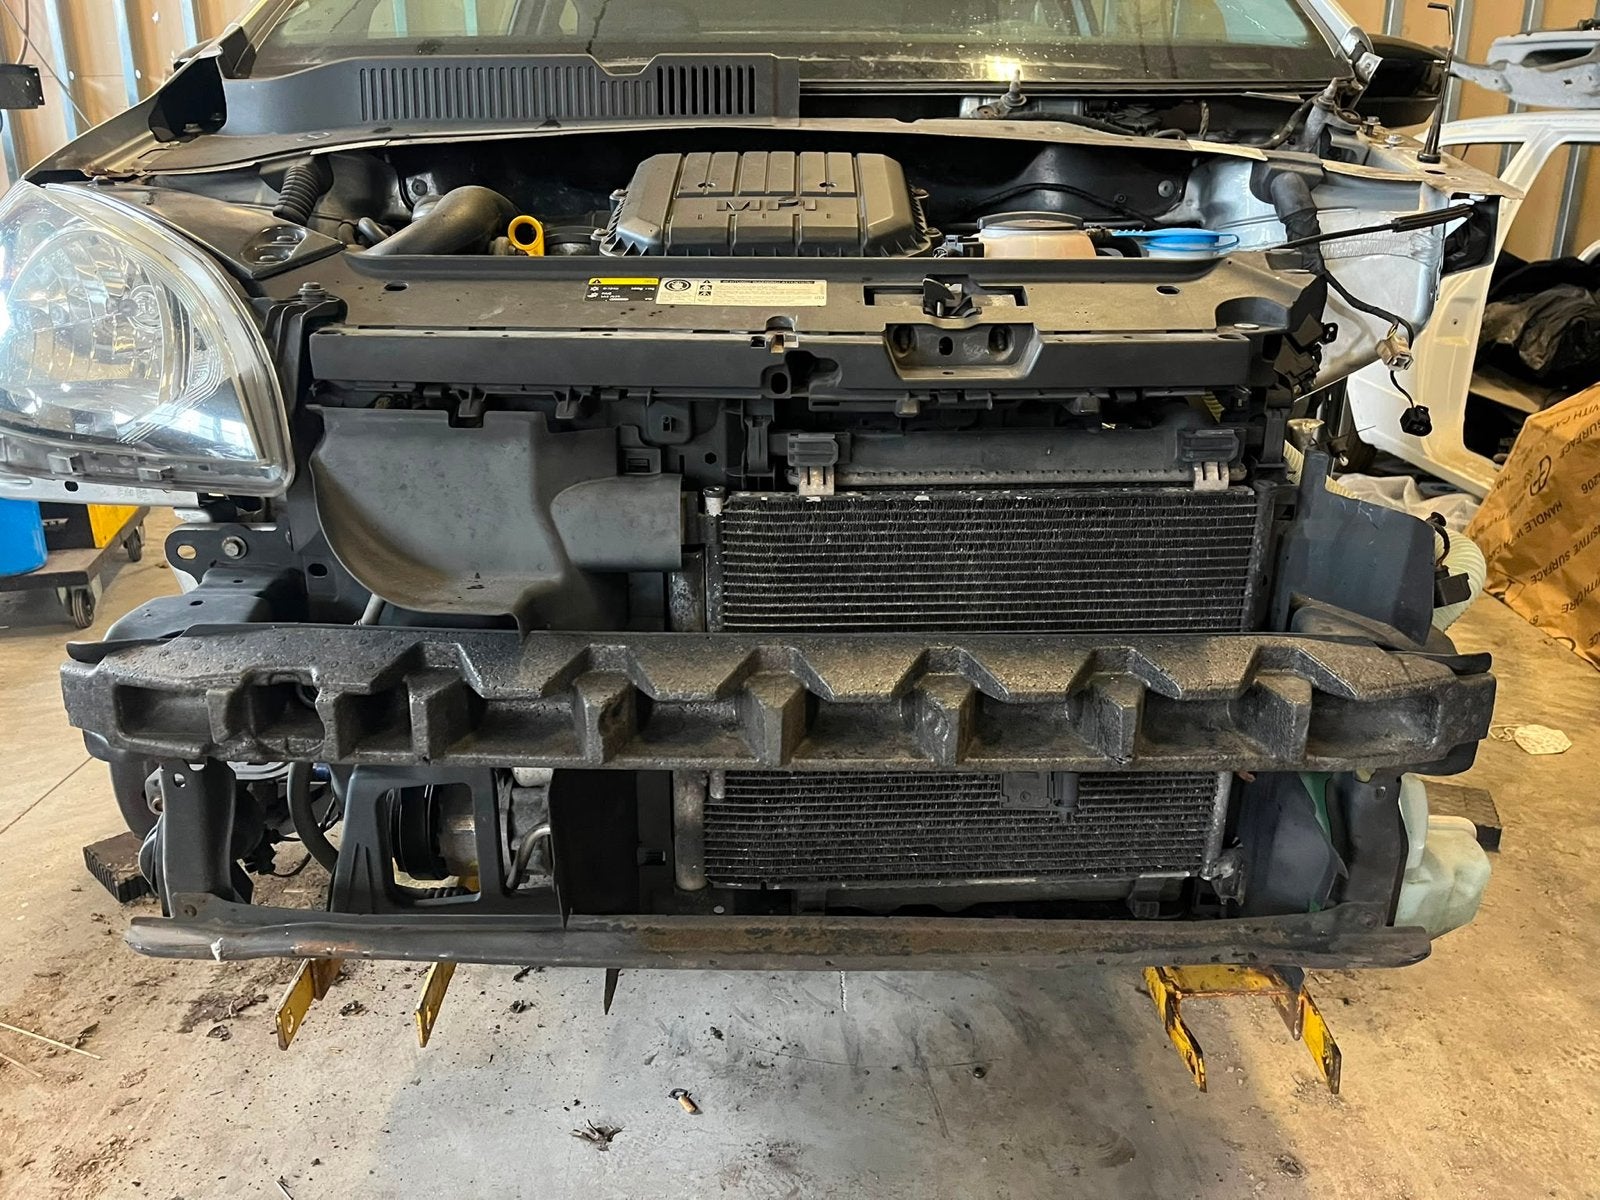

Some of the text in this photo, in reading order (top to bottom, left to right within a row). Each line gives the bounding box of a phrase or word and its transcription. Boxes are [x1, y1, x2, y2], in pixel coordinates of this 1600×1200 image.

[717, 196, 817, 211] MPI
[1581, 473, 1600, 494] 206
[1524, 501, 1562, 533] HANDLE
[1530, 551, 1571, 585] SURFACE
